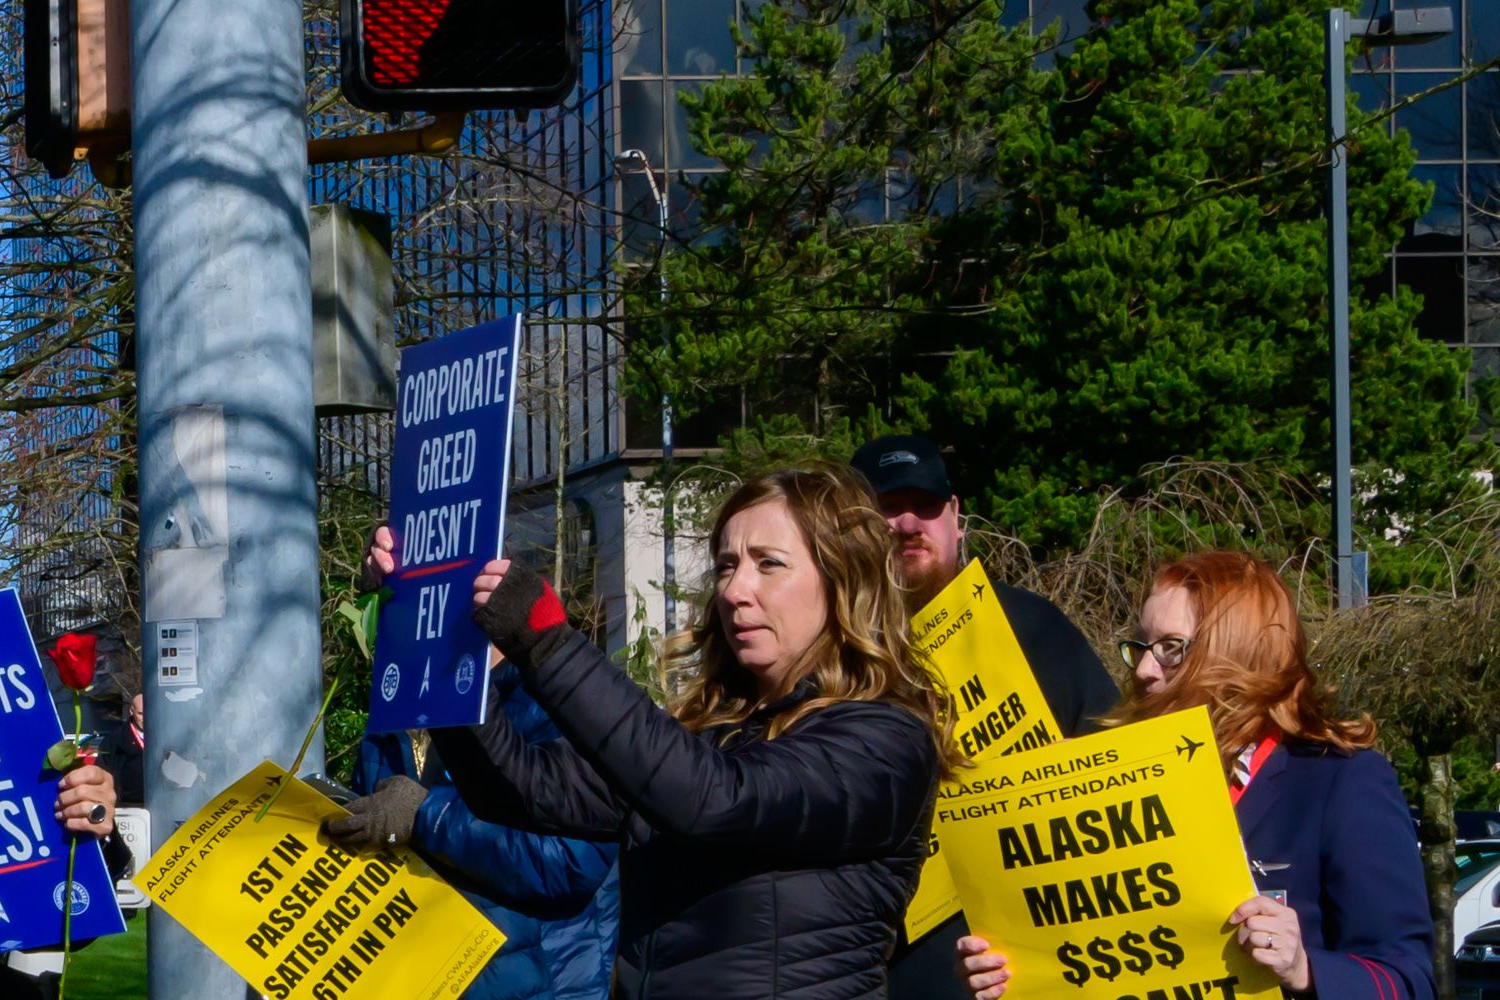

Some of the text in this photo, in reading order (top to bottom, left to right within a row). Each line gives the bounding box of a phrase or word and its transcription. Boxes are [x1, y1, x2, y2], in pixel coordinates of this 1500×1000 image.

[402, 346, 508, 428] CORPORATE
[416, 428, 477, 494] GREED
[402, 498, 482, 567] DOESN'T
[415, 583, 450, 641] FLY
[959, 674, 987, 712] IN
[959, 692, 1027, 759] ENGER
[937, 749, 1120, 800] ALASKA AIRLINES
[938, 763, 1166, 823] FLIGHT ATTENDANTS
[146, 798, 239, 891] ALASKA AIRLINES
[159, 793, 272, 902] FLIGHT ATTENDANTS
[998, 793, 1176, 870] ALASKA
[240, 833, 308, 903] 1ST IN
[1022, 861, 1182, 927] MAKES
[349, 929, 386, 966] IN
[372, 888, 419, 939] PAY
[464, 929, 489, 963] AFL-CIO
[1056, 924, 1185, 988] $$$$
[457, 938, 500, 987] AFAAlaska.org
